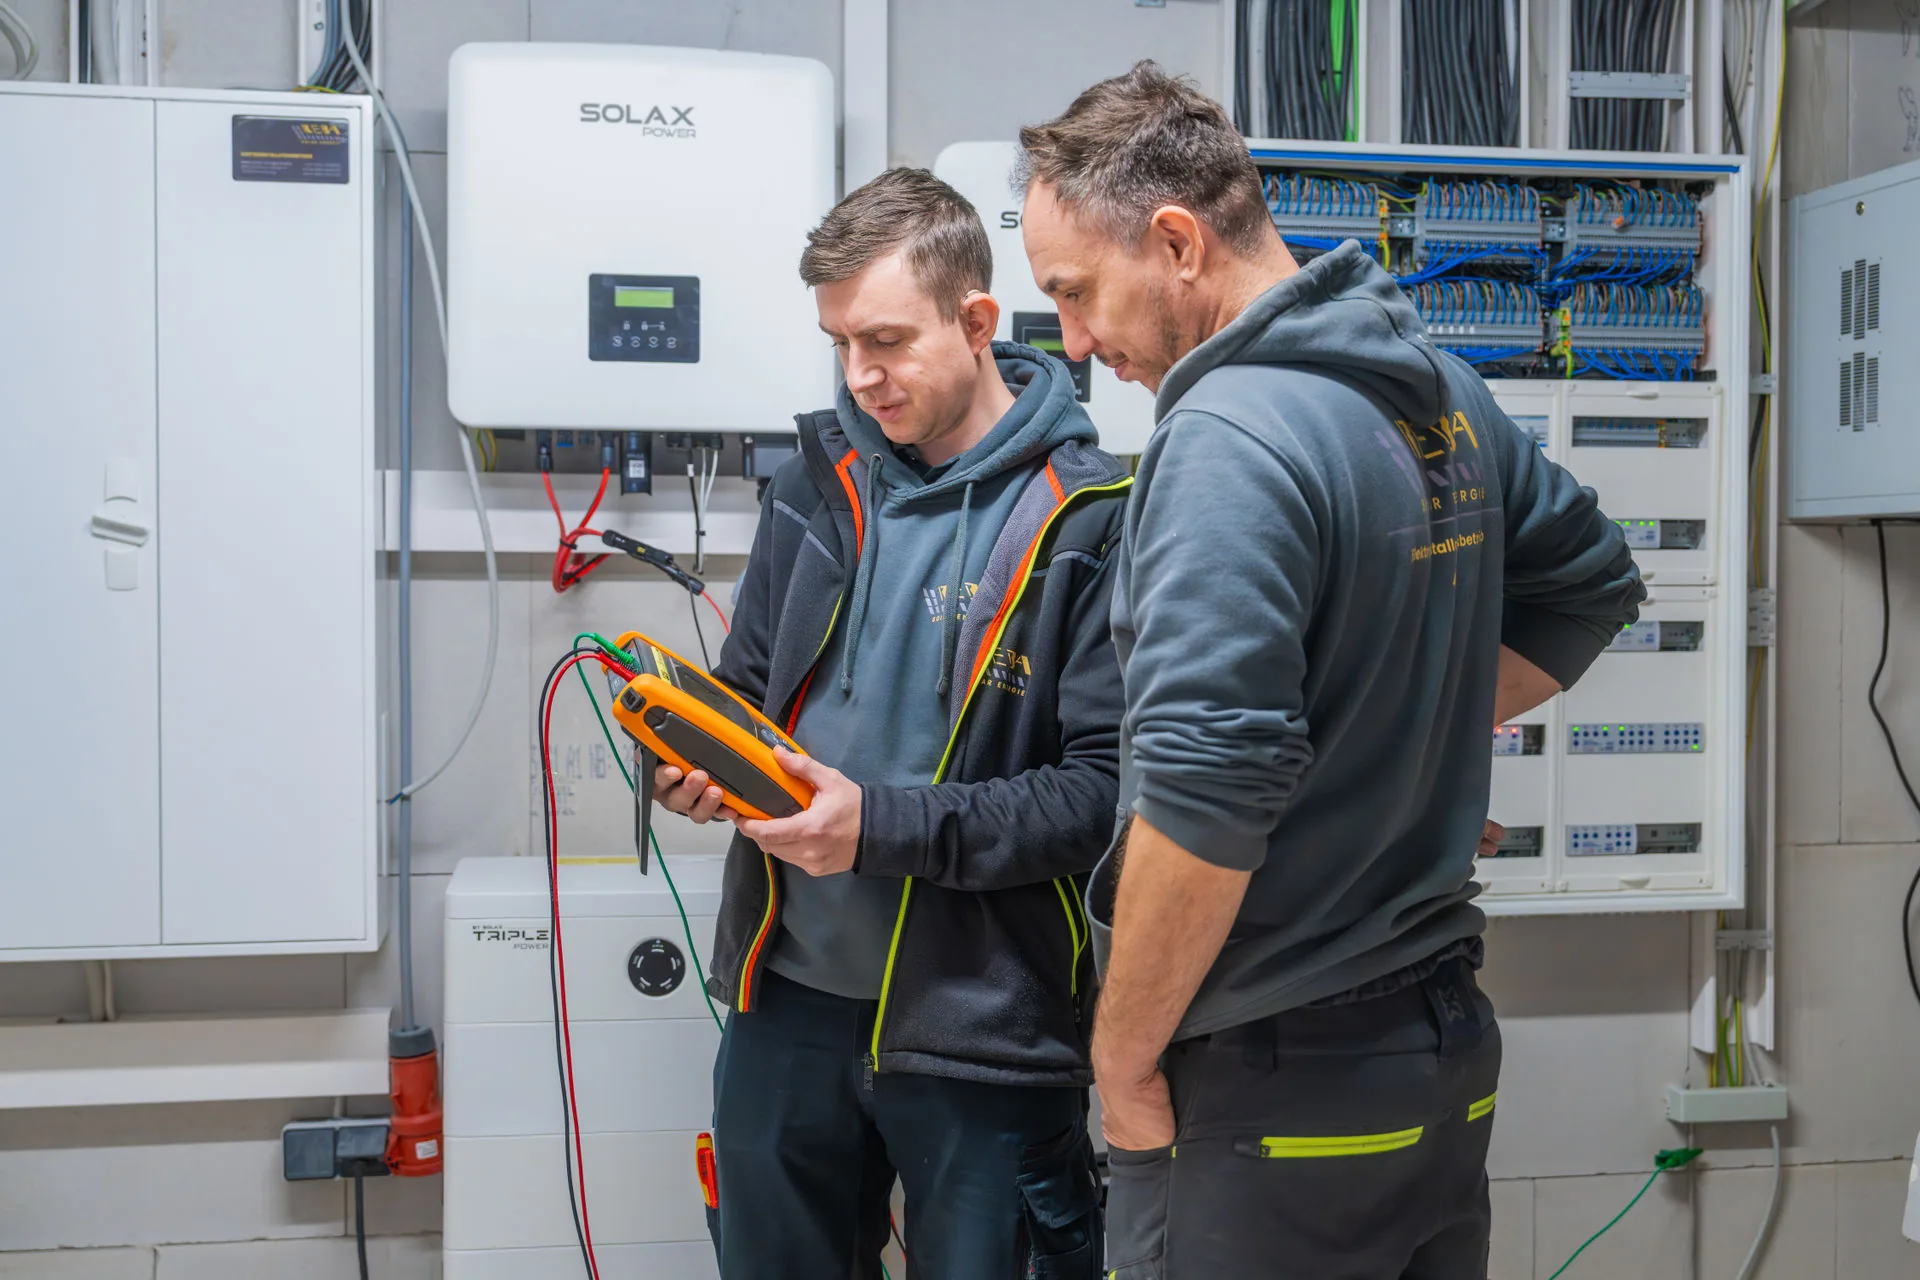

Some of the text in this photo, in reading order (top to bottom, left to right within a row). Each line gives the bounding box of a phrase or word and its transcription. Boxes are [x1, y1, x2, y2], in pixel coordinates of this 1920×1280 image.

[580, 103, 695, 127] SOLAX
[642, 127, 697, 139] POWER
[1000, 211, 1023, 229] S
[472, 929, 549, 941] TRIPLE
